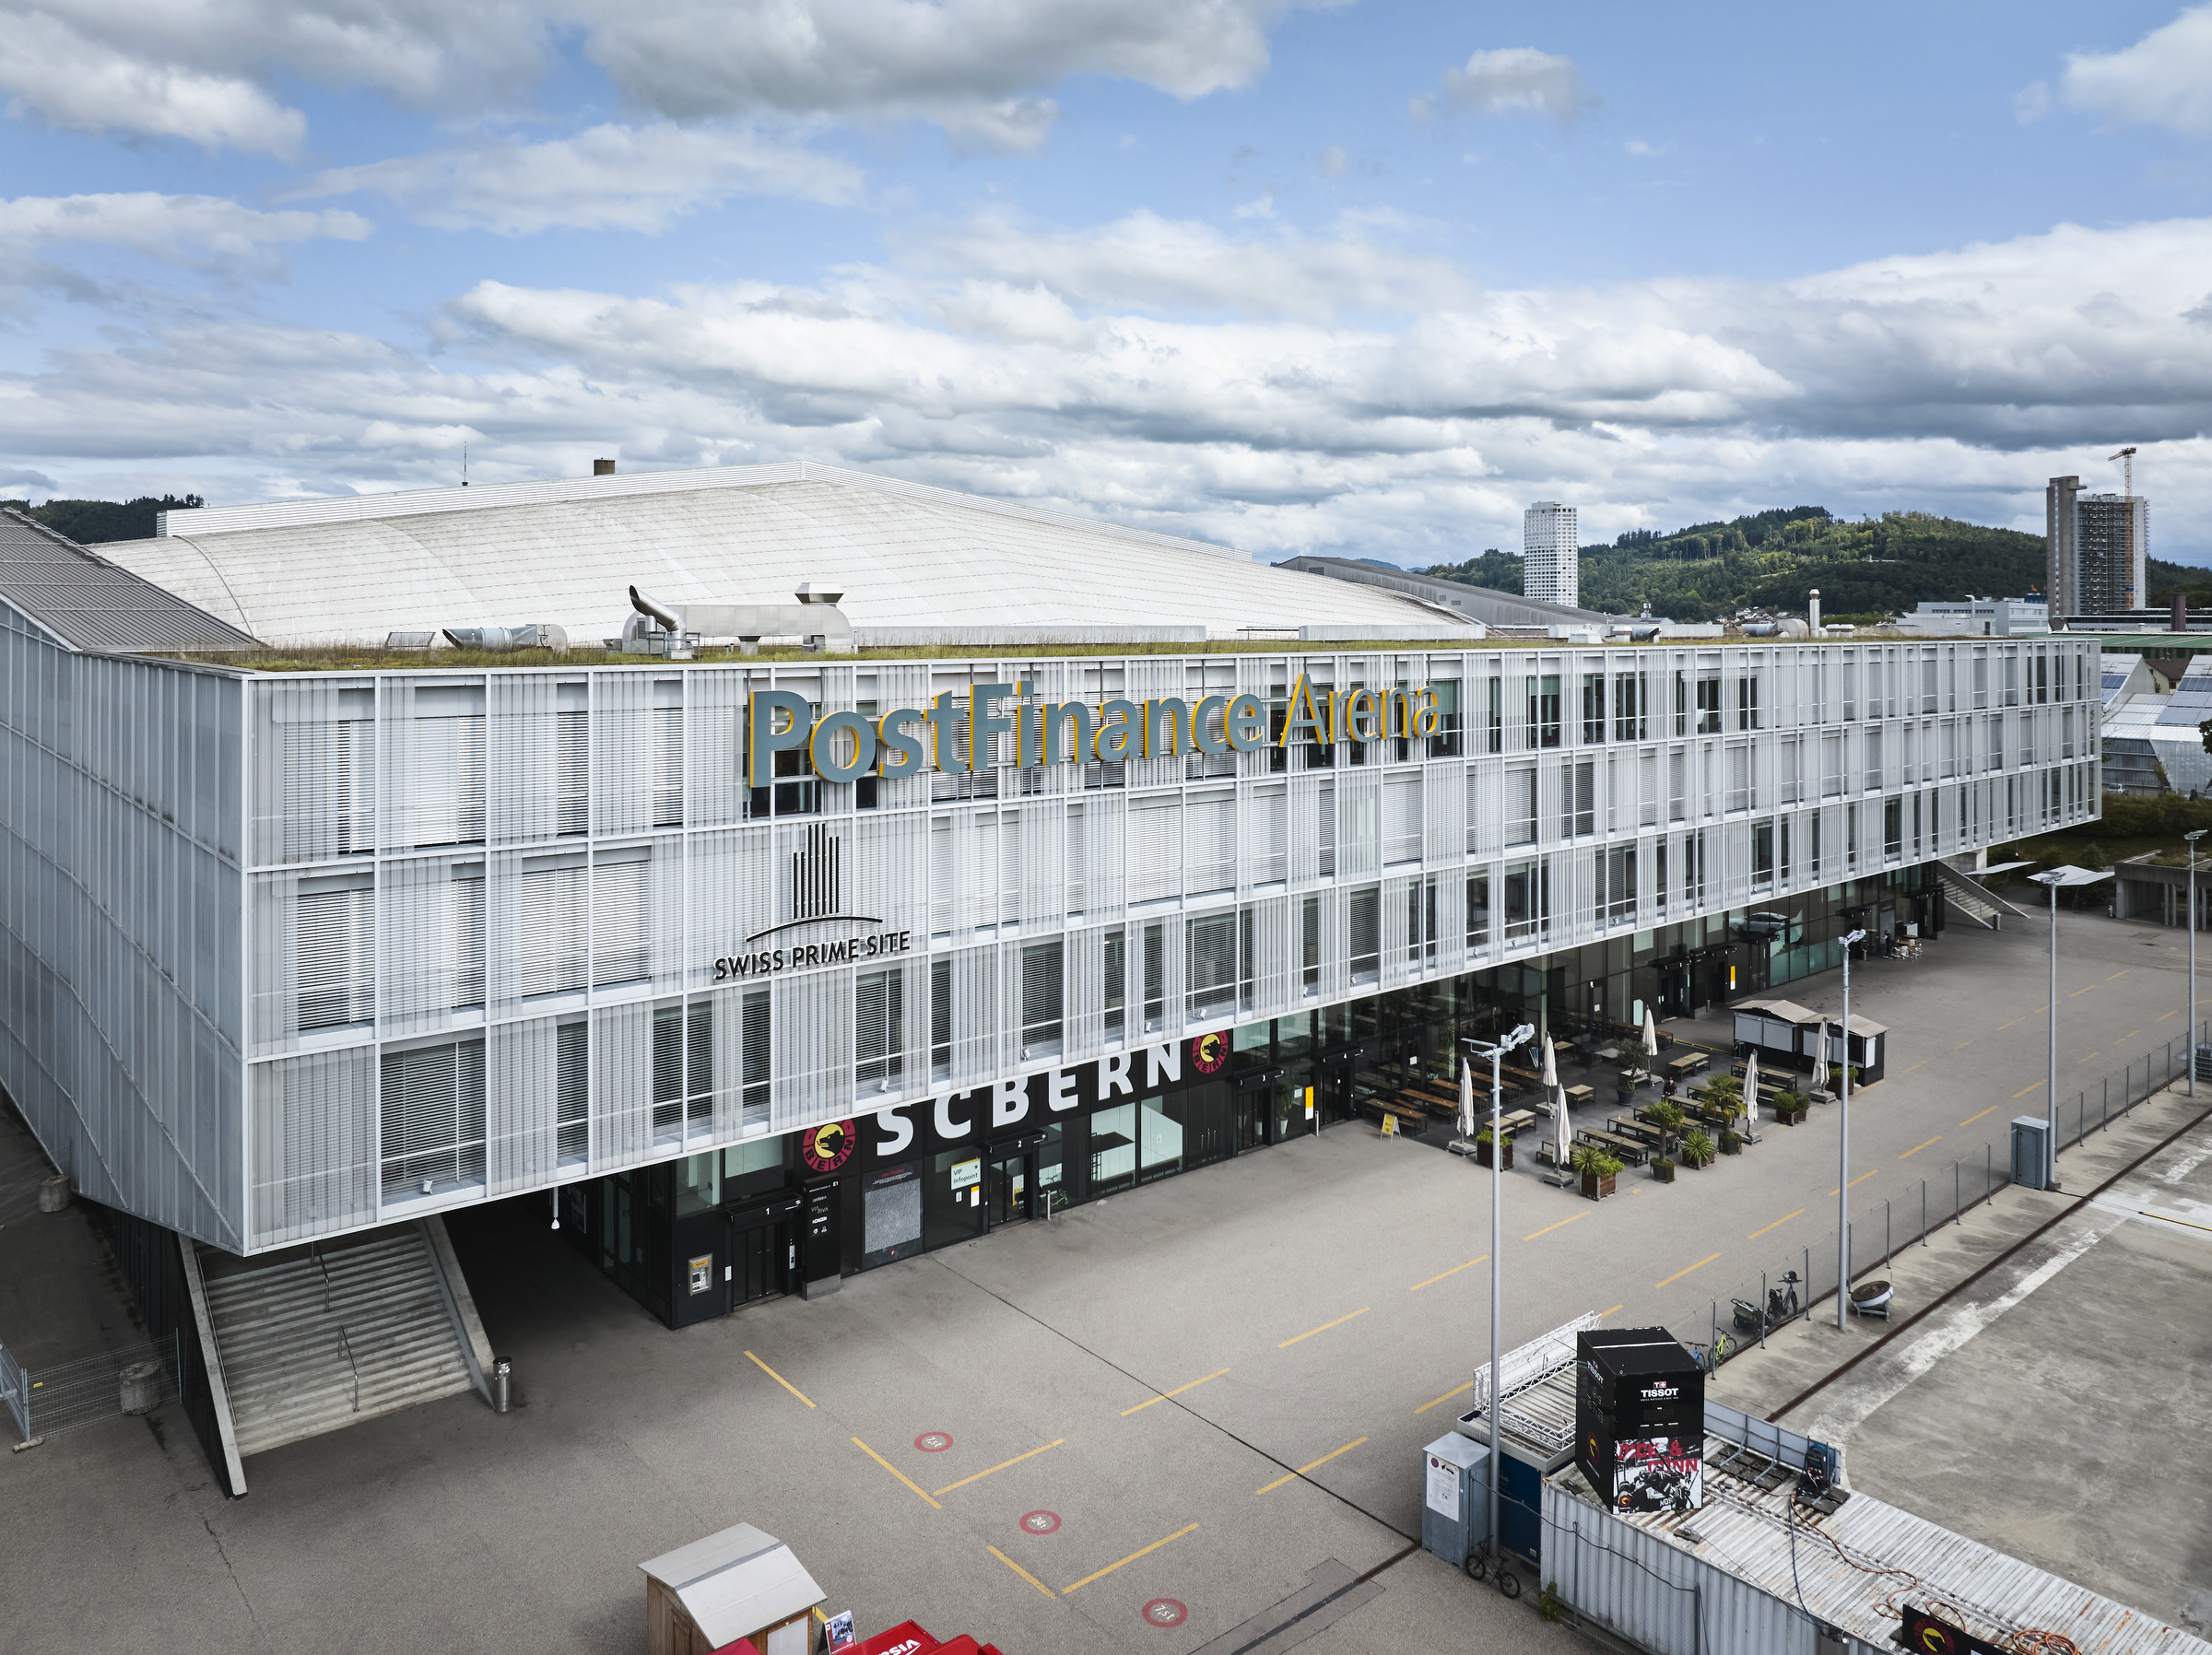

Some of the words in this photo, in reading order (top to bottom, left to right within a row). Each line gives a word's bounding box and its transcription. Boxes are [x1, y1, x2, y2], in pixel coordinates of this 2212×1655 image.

[750, 680, 1265, 788] PostFinance
[1278, 674, 1442, 748] Arena
[713, 949, 784, 980] SWISS
[793, 938, 859, 968] PRIME
[866, 931, 911, 956] SITE
[1194, 1047, 1227, 1073] BERN
[805, 1138, 854, 1170] BERN
[1018, 1140, 1022, 1148] 2
[953, 1172, 979, 1184] Infopoint
[1640, 1388, 1679, 1398] TISSOT
[1669, 1439, 1684, 1456] &
